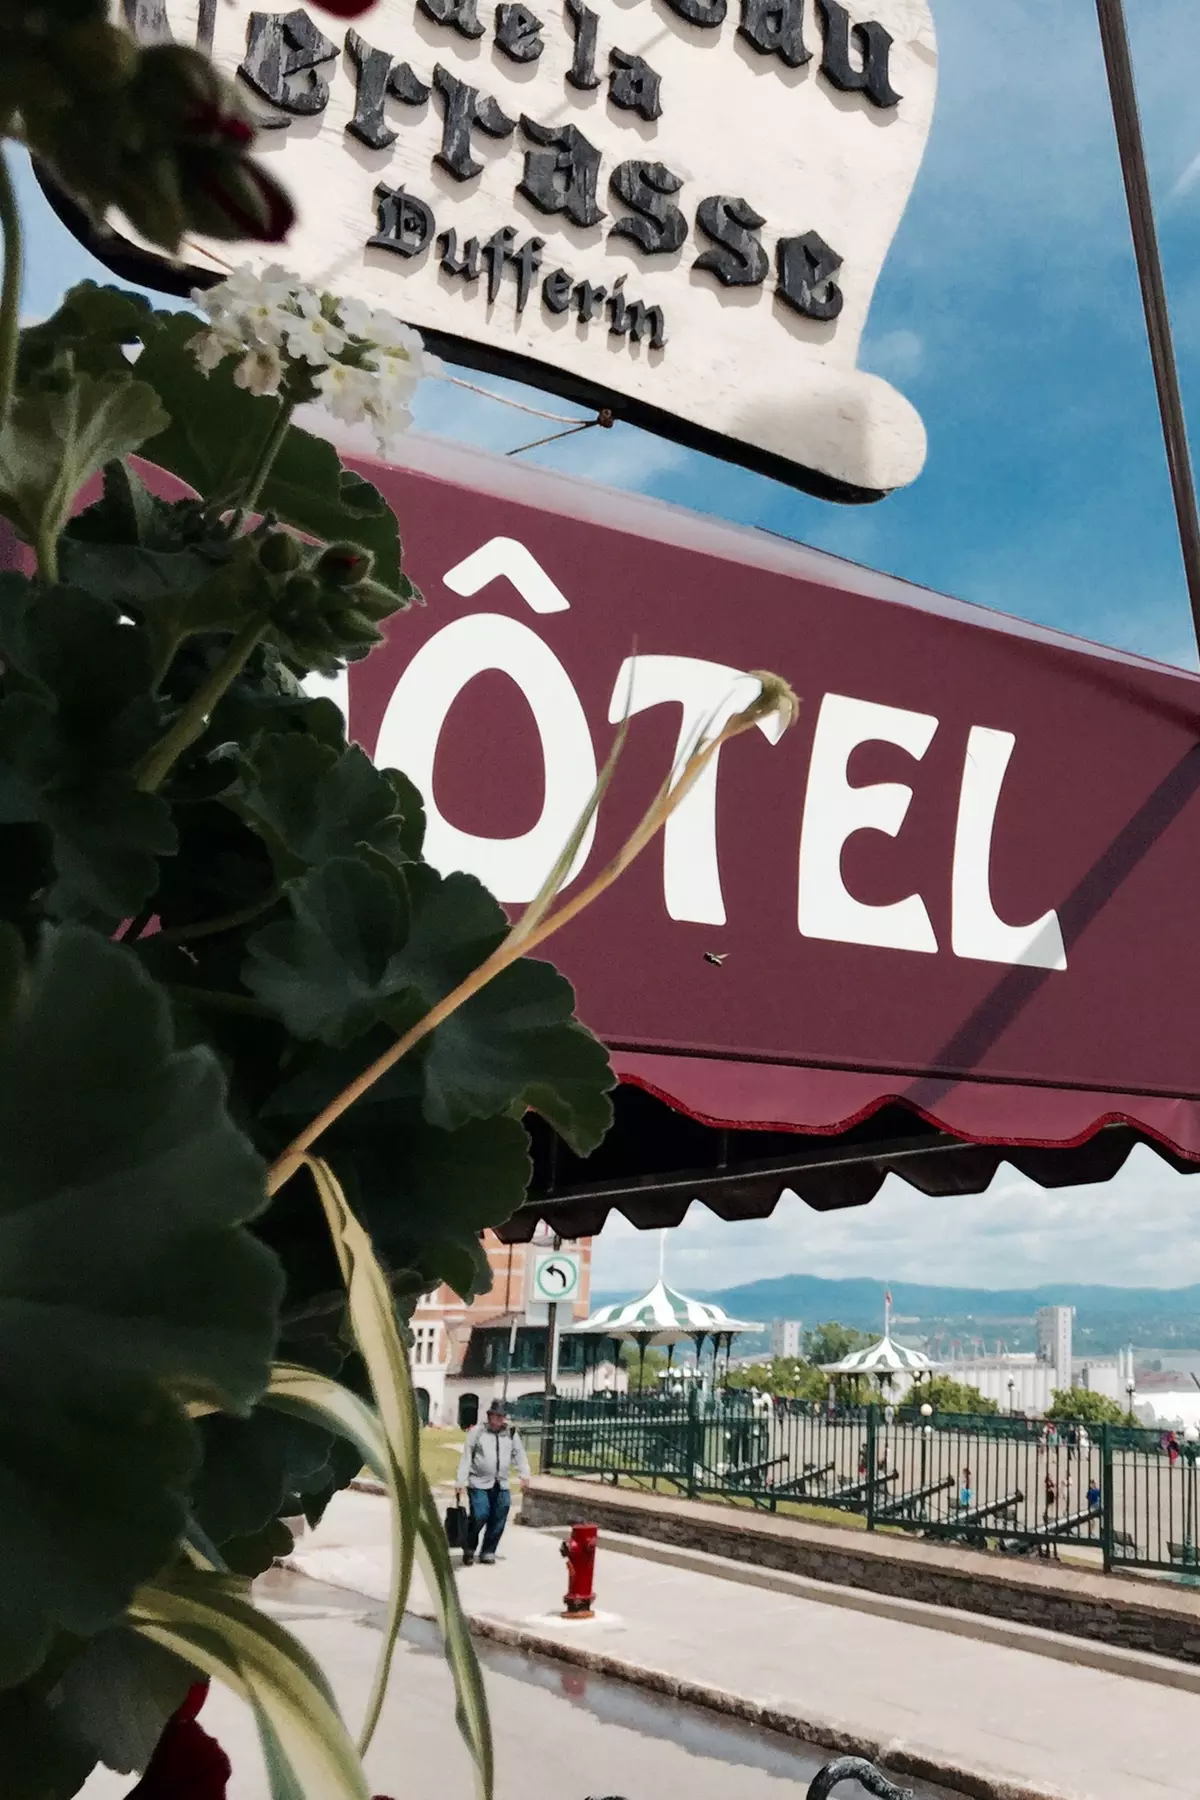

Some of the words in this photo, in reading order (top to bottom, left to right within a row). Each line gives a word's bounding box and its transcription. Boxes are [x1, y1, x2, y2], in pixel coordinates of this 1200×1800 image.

[564, 0, 664, 121] la
[365, 180, 669, 350] Dufferin
[299, 536, 1068, 972] ÔTEL
